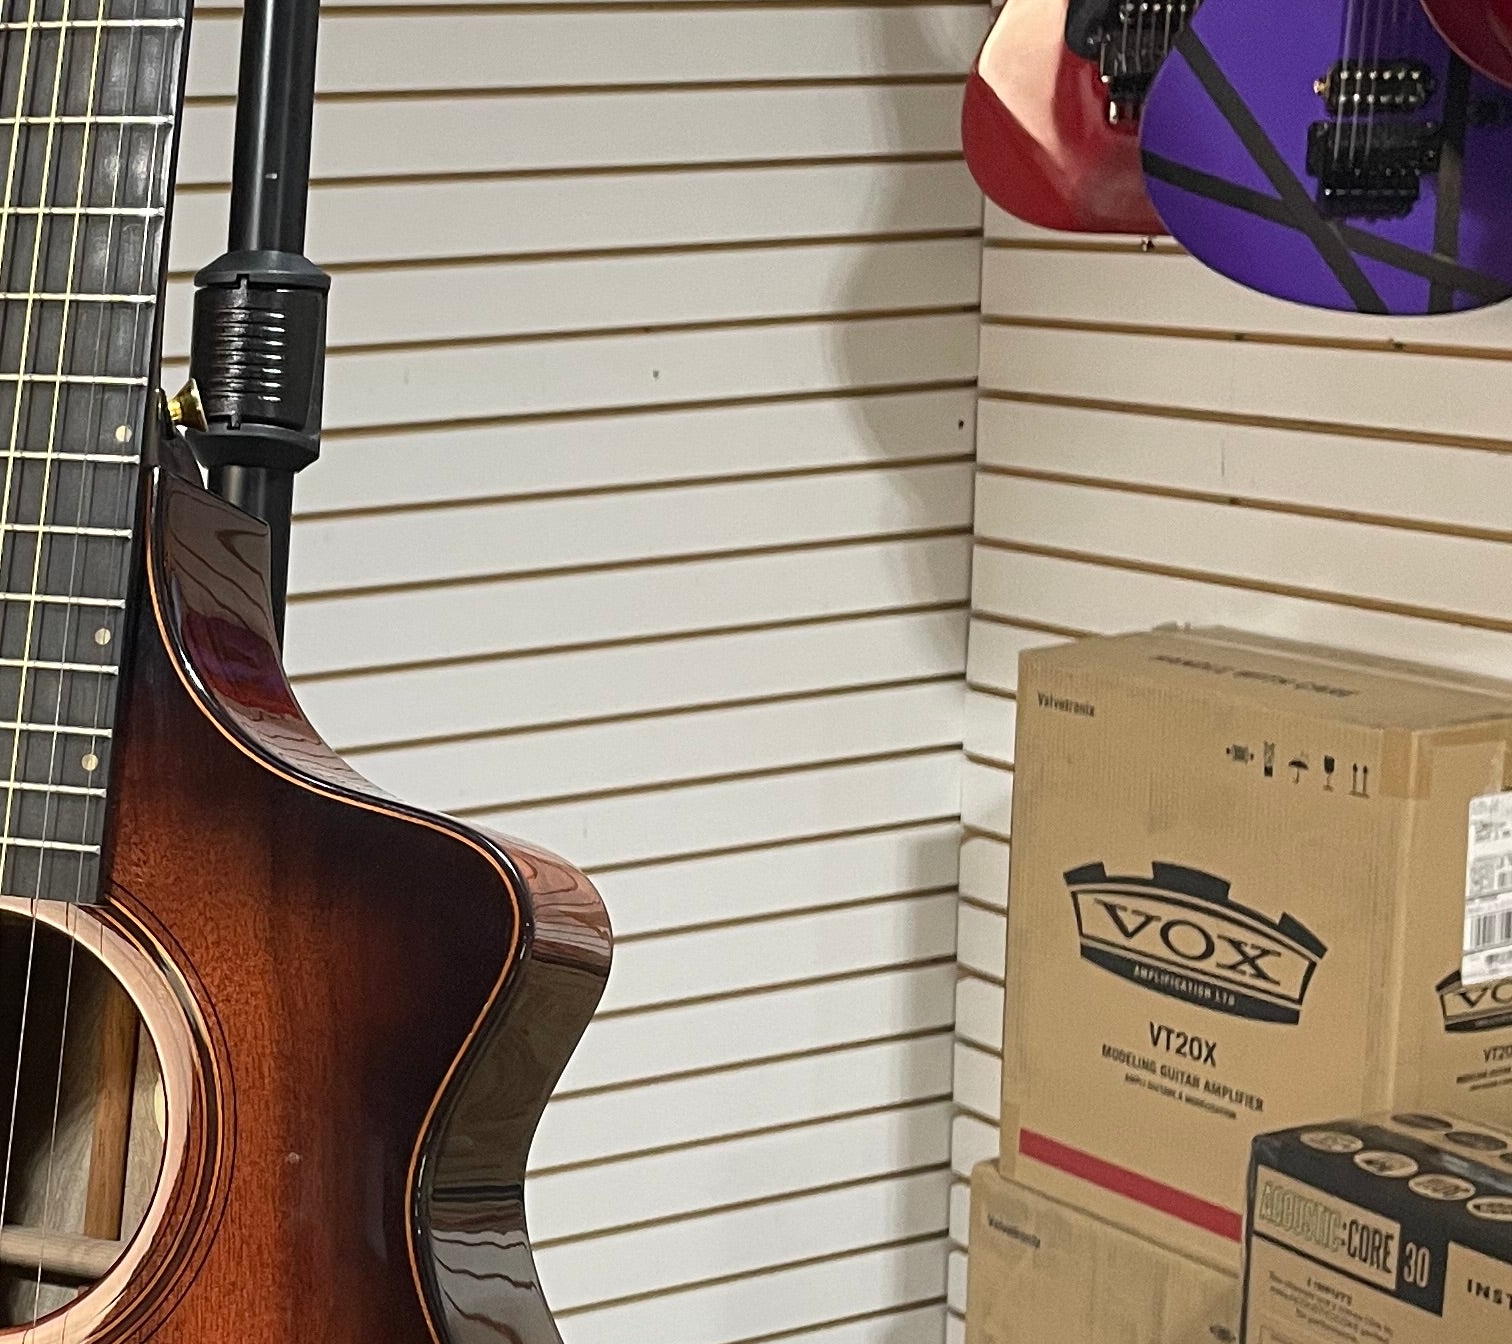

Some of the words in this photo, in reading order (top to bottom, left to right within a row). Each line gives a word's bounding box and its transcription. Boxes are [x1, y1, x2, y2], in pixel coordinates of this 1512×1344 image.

[1094, 897, 1282, 987] VOX
[1133, 965, 1212, 1000] AMPLIFICATION
[1149, 1020, 1217, 1068] VT20X
[1101, 1043, 1157, 1075] MODELING
[1160, 1063, 1200, 1090] GUITAR
[1203, 1078, 1264, 1113] AMPLIFIER
[1404, 1241, 1431, 1288] 30
